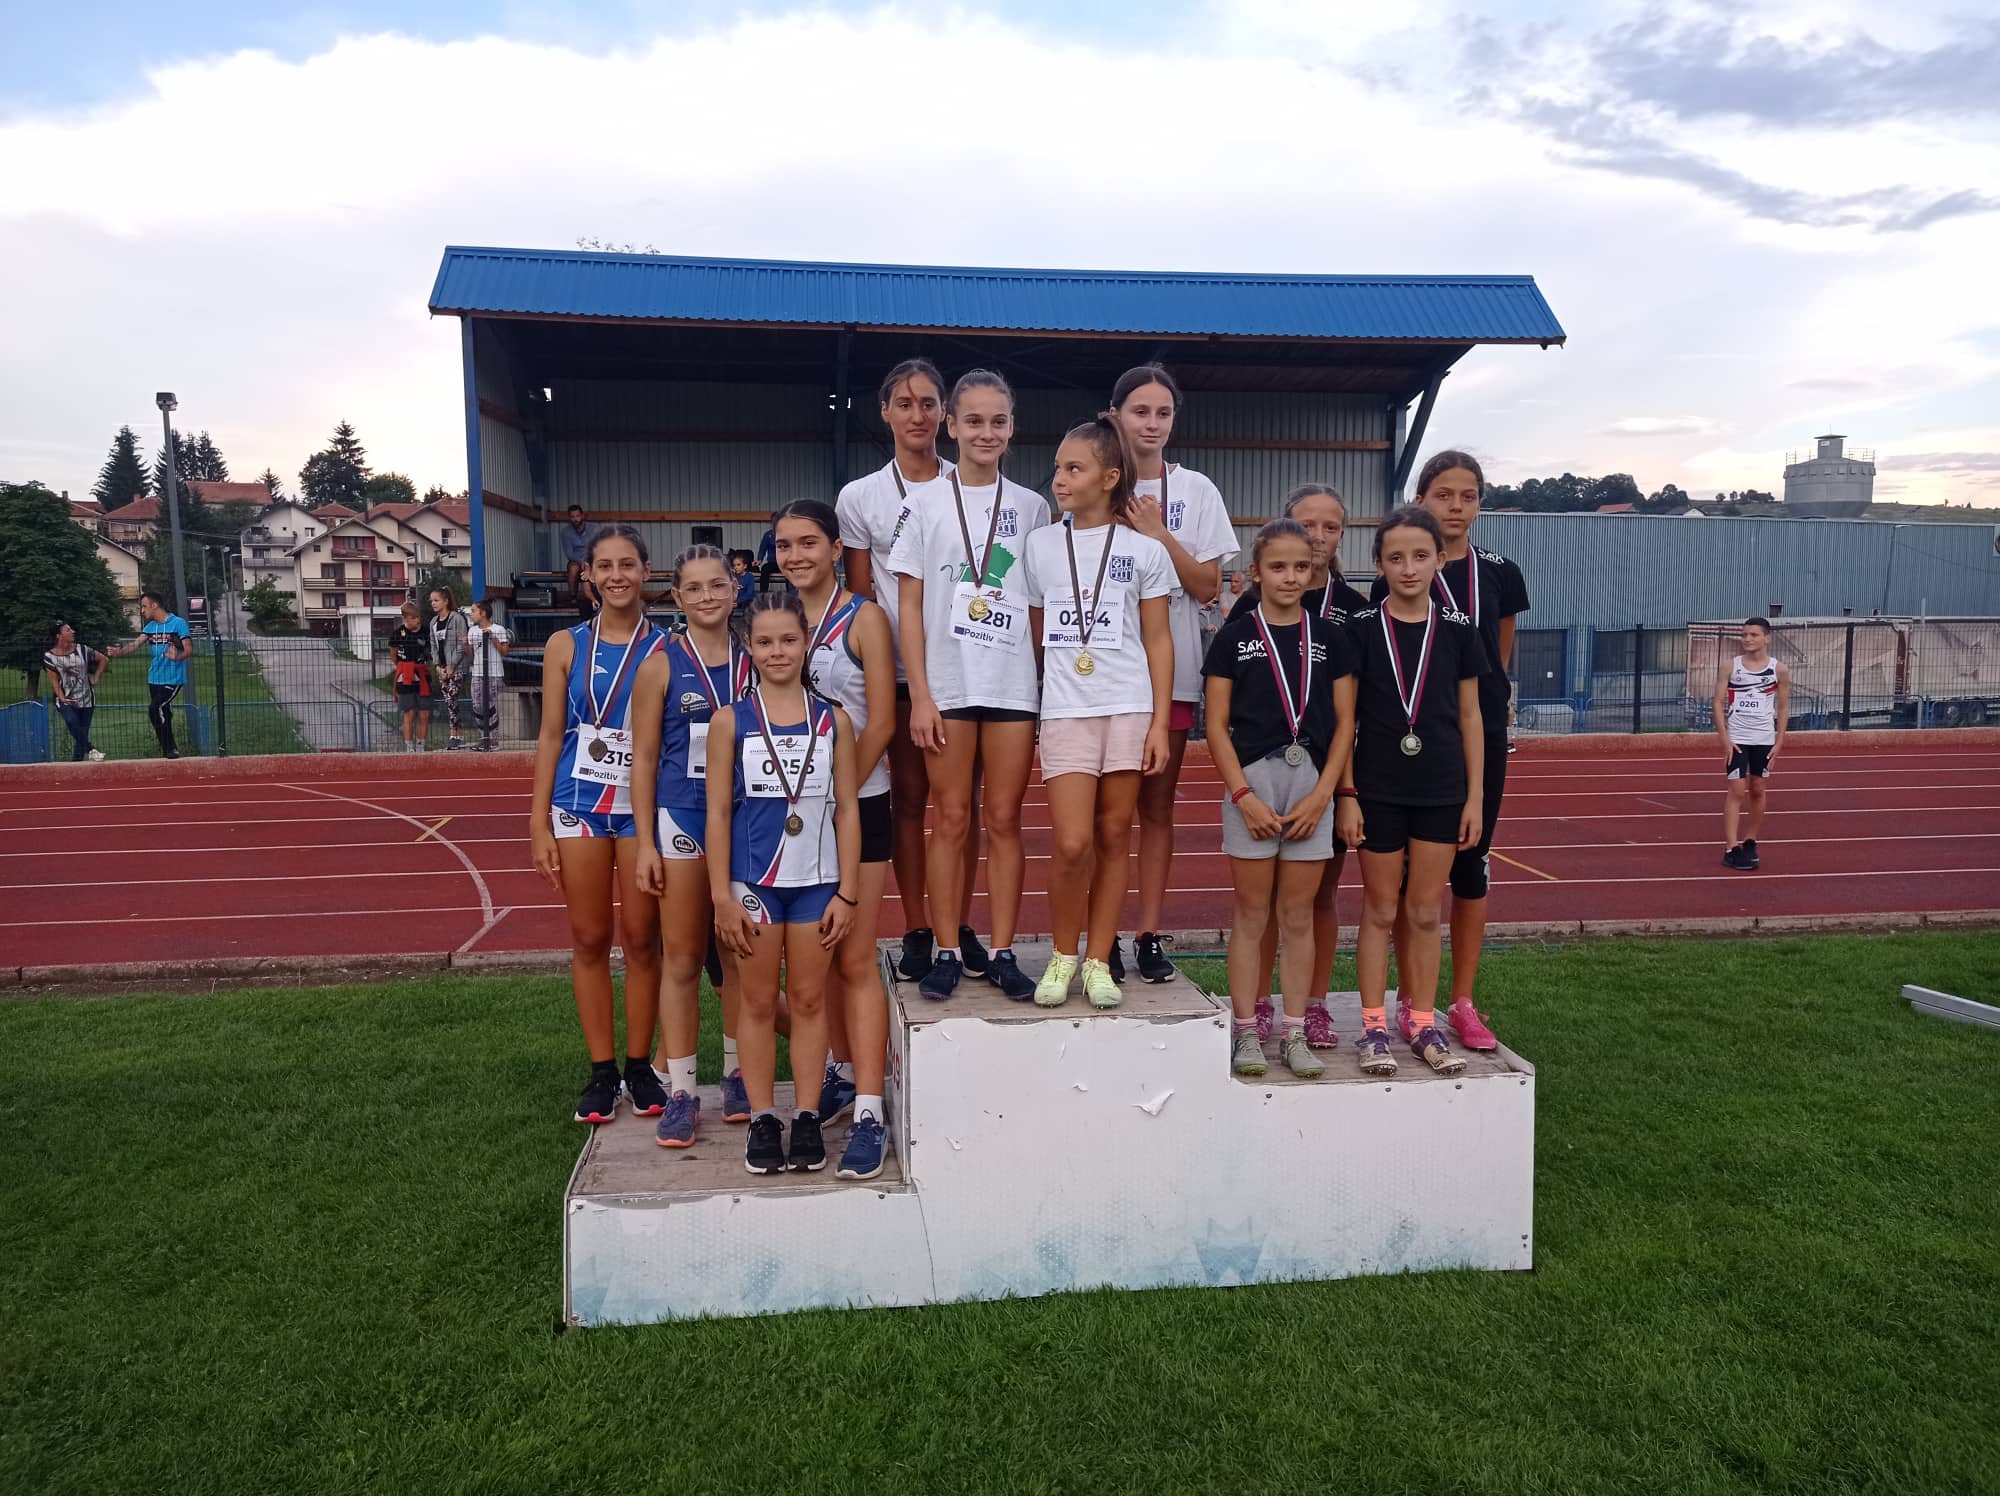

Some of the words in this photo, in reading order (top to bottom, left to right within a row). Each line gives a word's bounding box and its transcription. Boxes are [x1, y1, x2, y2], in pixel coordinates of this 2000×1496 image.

[968, 609, 1012, 630] 281
[1059, 610, 1111, 627] 0284
[1442, 606, 1470, 624] SAK
[963, 628, 994, 642] Pozitiv
[1058, 633, 1083, 642] Pozit
[1237, 640, 1266, 653] SAK
[1739, 700, 1760, 709] 0261
[593, 750, 633, 767] 319
[588, 769, 618, 781] Pozitiv
